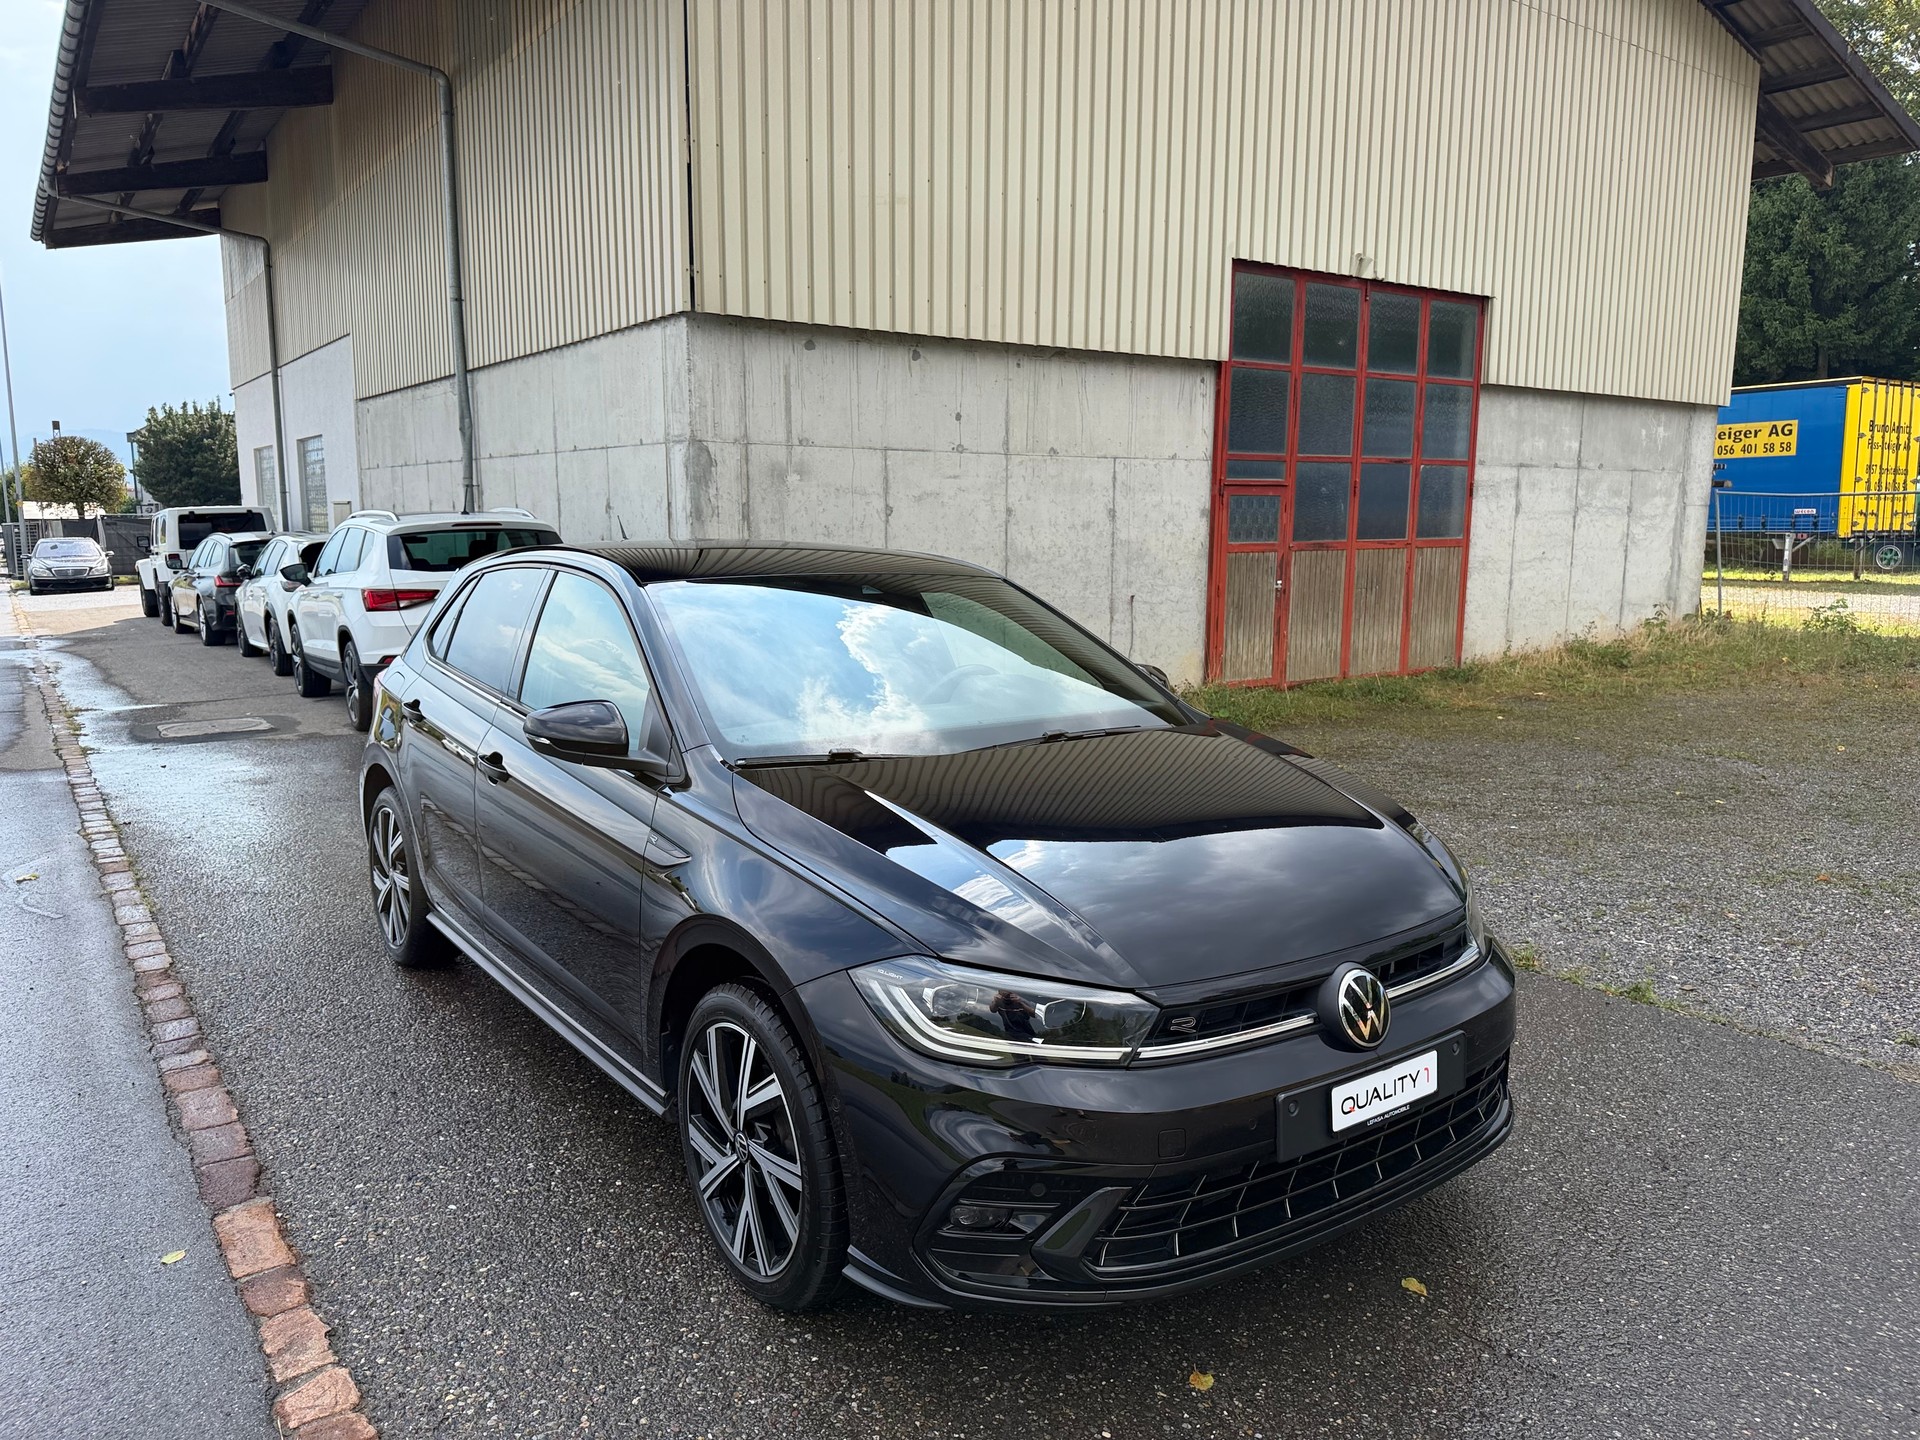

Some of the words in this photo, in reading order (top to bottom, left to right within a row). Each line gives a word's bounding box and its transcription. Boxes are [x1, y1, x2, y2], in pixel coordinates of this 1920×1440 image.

[1715, 427, 1762, 443] eiger
[1768, 423, 1793, 437] AG
[1717, 444, 1735, 456] 056
[1740, 443, 1757, 454] 401
[1763, 442, 1775, 454] 58
[1779, 441, 1792, 453] 58
